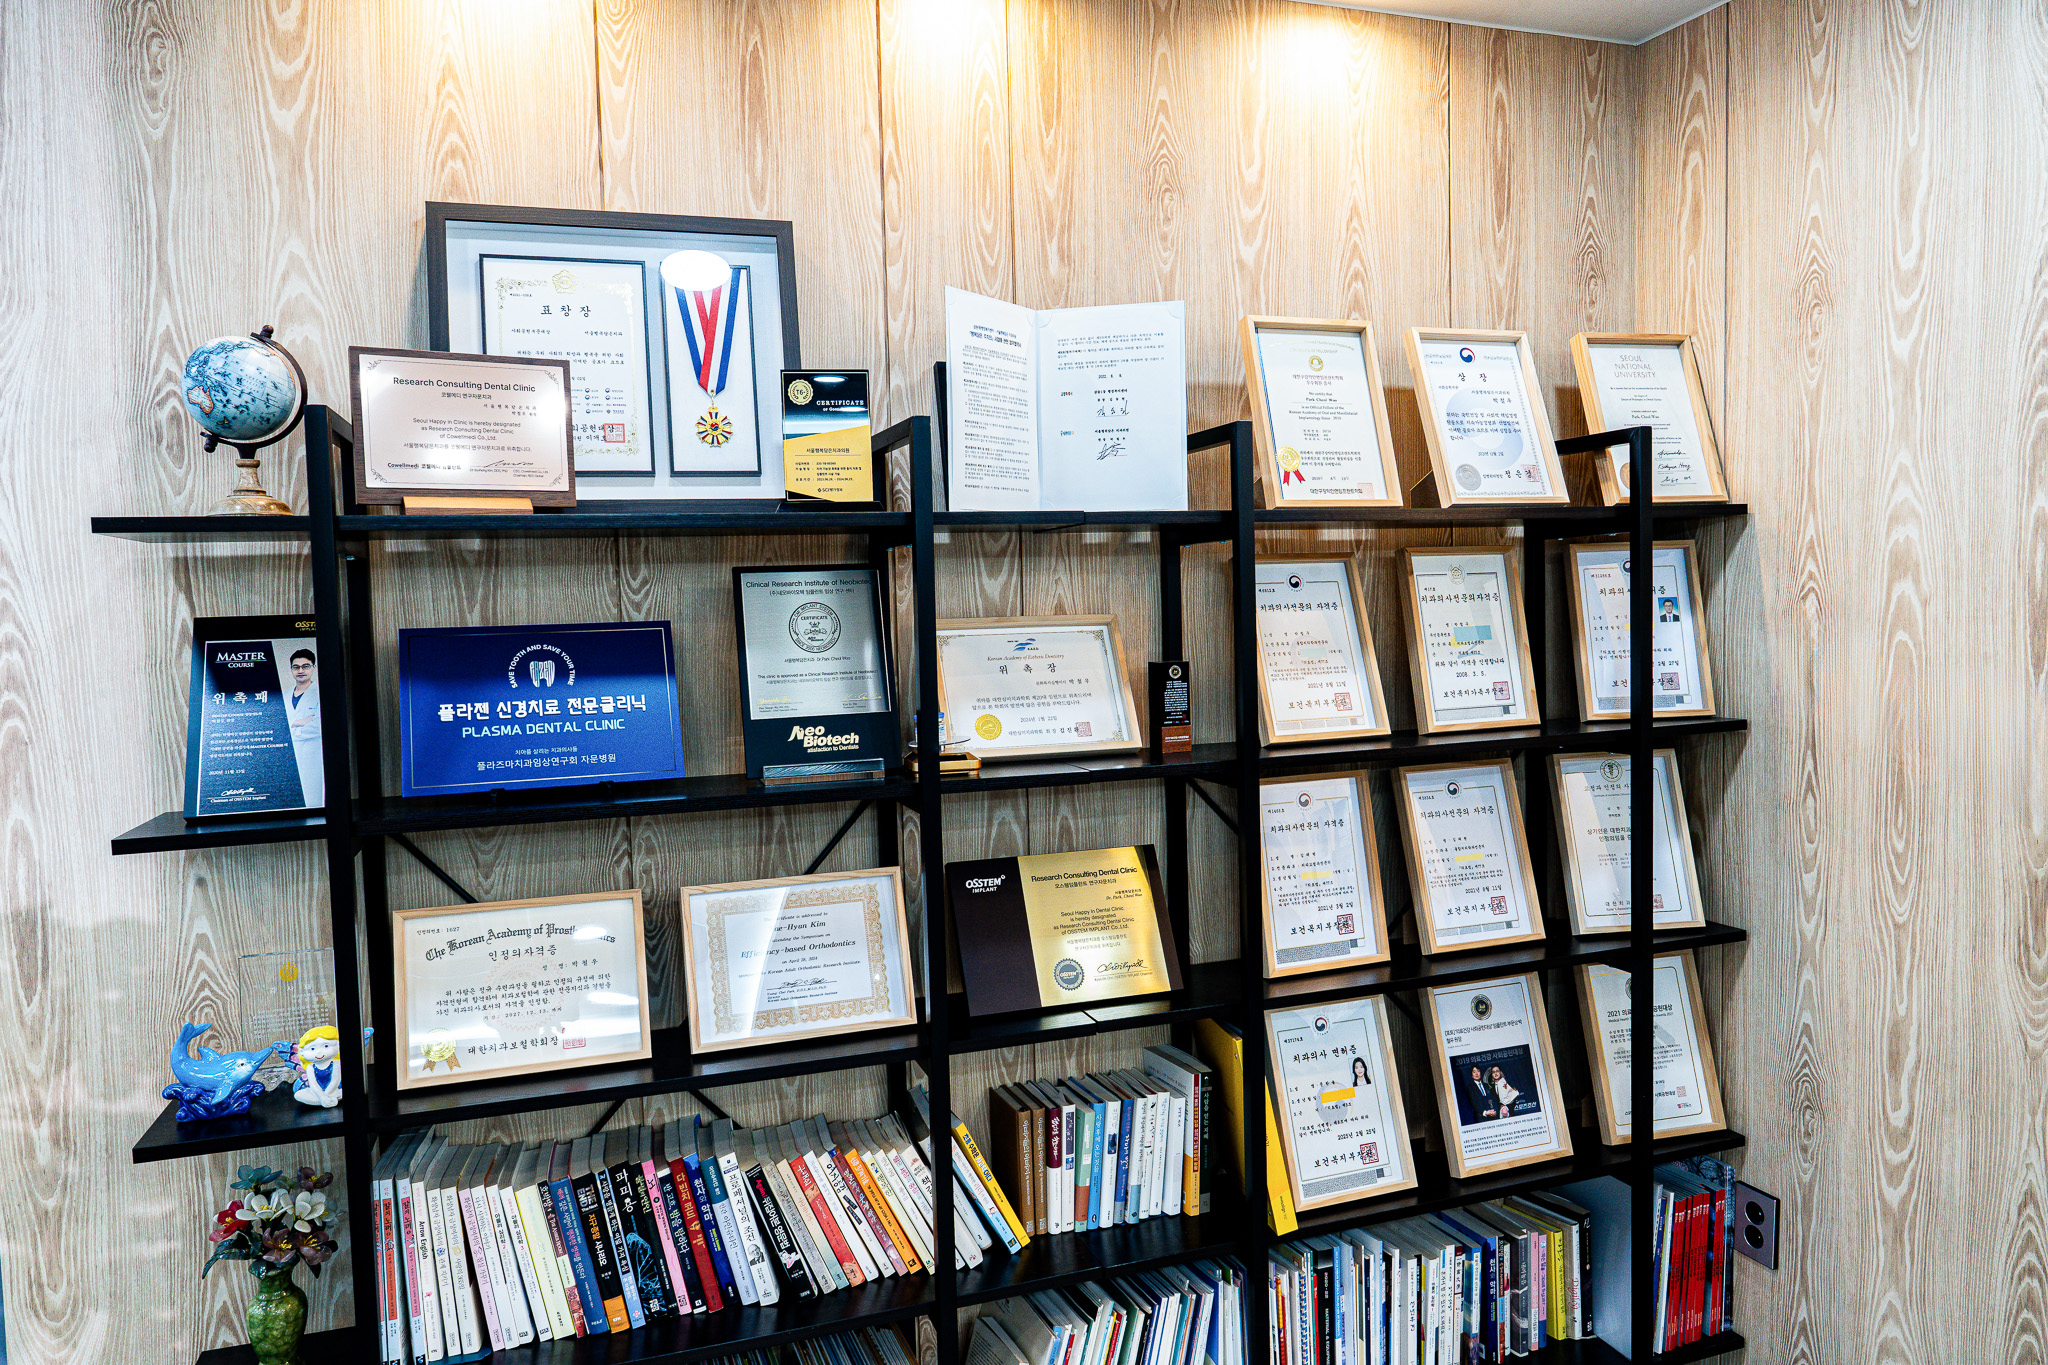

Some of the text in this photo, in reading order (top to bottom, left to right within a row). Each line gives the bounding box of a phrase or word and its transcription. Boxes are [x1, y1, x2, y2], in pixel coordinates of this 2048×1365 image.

[393, 377, 536, 392] Research Consulting Dental Clinic
[1316, 602, 1338, 611] 자격증
[508, 644, 575, 689] SAVE TOOTH AND SAVE YOUR TIME
[438, 695, 647, 722] 플라젠 신경치료 전문클리닉
[462, 718, 625, 738] PLASMA DENTAL CLINIC
[788, 726, 825, 741] Neo
[803, 733, 859, 747] Biotech
[477, 753, 616, 771] 플라즈마치과임상연구회 자문병원
[1473, 806, 1494, 814] 자격증
[966, 877, 1002, 889] OSSTEM
[1031, 874, 1062, 882] Research
[1063, 870, 1097, 880] Consulting
[972, 886, 997, 894] IMPLANT
[425, 924, 544, 961] The Korean Academy of
[809, 940, 856, 950] Orthodontics
[1293, 1045, 1357, 1063] 치과의사 면허증
[575, 1183, 597, 1207] THE END
[611, 1167, 639, 1214] 파피용
[752, 1177, 768, 1199] Again!
[599, 1179, 611, 1199] 사랑을
[609, 1218, 619, 1232] 하는
[615, 1244, 626, 1259] 가지
[668, 1208, 682, 1228] 밤을
[682, 1201, 696, 1219] 코드
[700, 1203, 713, 1222] 악마
[759, 1195, 782, 1228] 뒤집어본
[586, 1212, 608, 1266] 지구종말 시나리오
[673, 1227, 690, 1255] 탐하다
[772, 1224, 791, 1250] 영문법
[420, 1239, 428, 1259] English
[1570, 1277, 1580, 1310] Digilog
